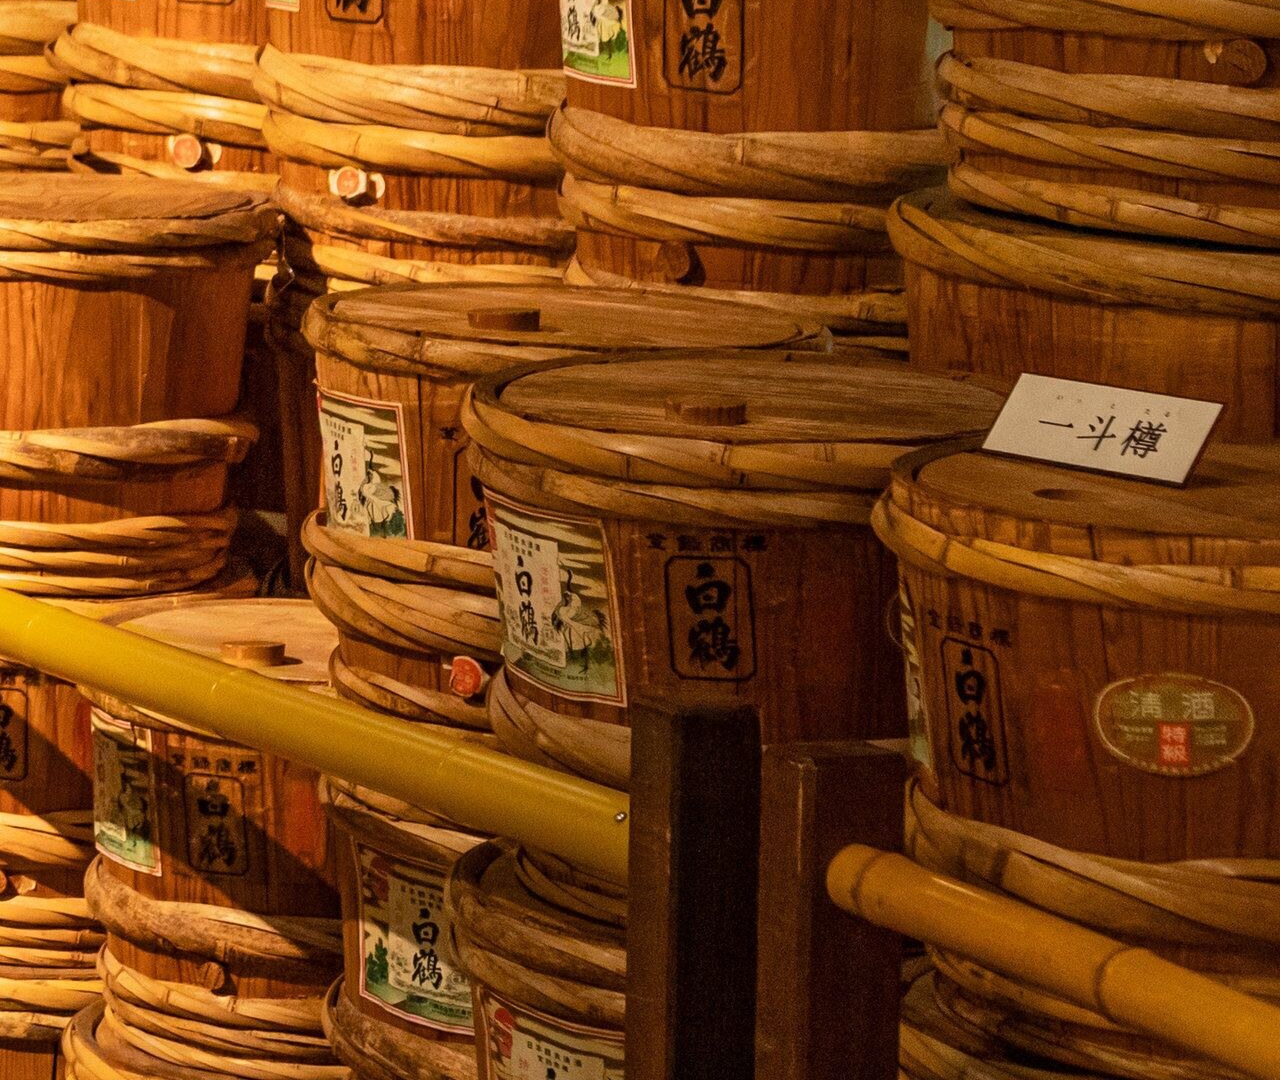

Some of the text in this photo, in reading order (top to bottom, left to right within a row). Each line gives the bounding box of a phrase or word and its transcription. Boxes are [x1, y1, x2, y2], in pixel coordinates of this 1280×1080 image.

[1037, 414, 1168, 460] 一斗樽
[515, 554, 540, 647] 白鶴
[685, 562, 741, 672] 白鶴
[955, 647, 998, 773] 白鶴
[196, 779, 237, 867] 白鶴
[410, 906, 444, 991] 白鶴
